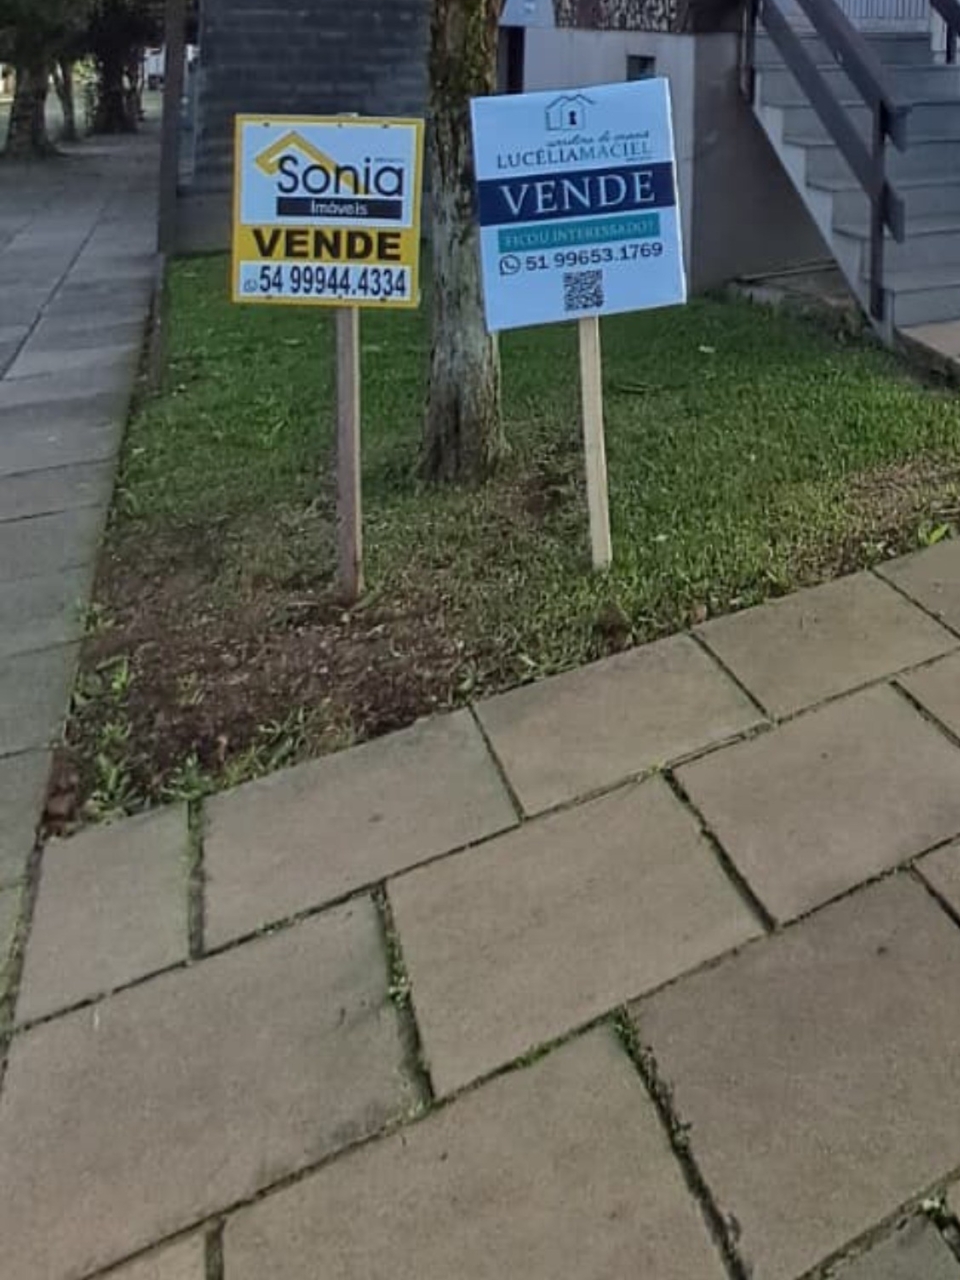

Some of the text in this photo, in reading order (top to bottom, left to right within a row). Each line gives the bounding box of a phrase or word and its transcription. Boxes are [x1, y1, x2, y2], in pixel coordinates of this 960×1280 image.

[277, 155, 403, 196] Sonia
[501, 171, 655, 216] VENDE
[253, 228, 401, 261] VENDE
[526, 242, 663, 271] 51 99653.1769
[259, 265, 406, 297] 54 99944.4334
